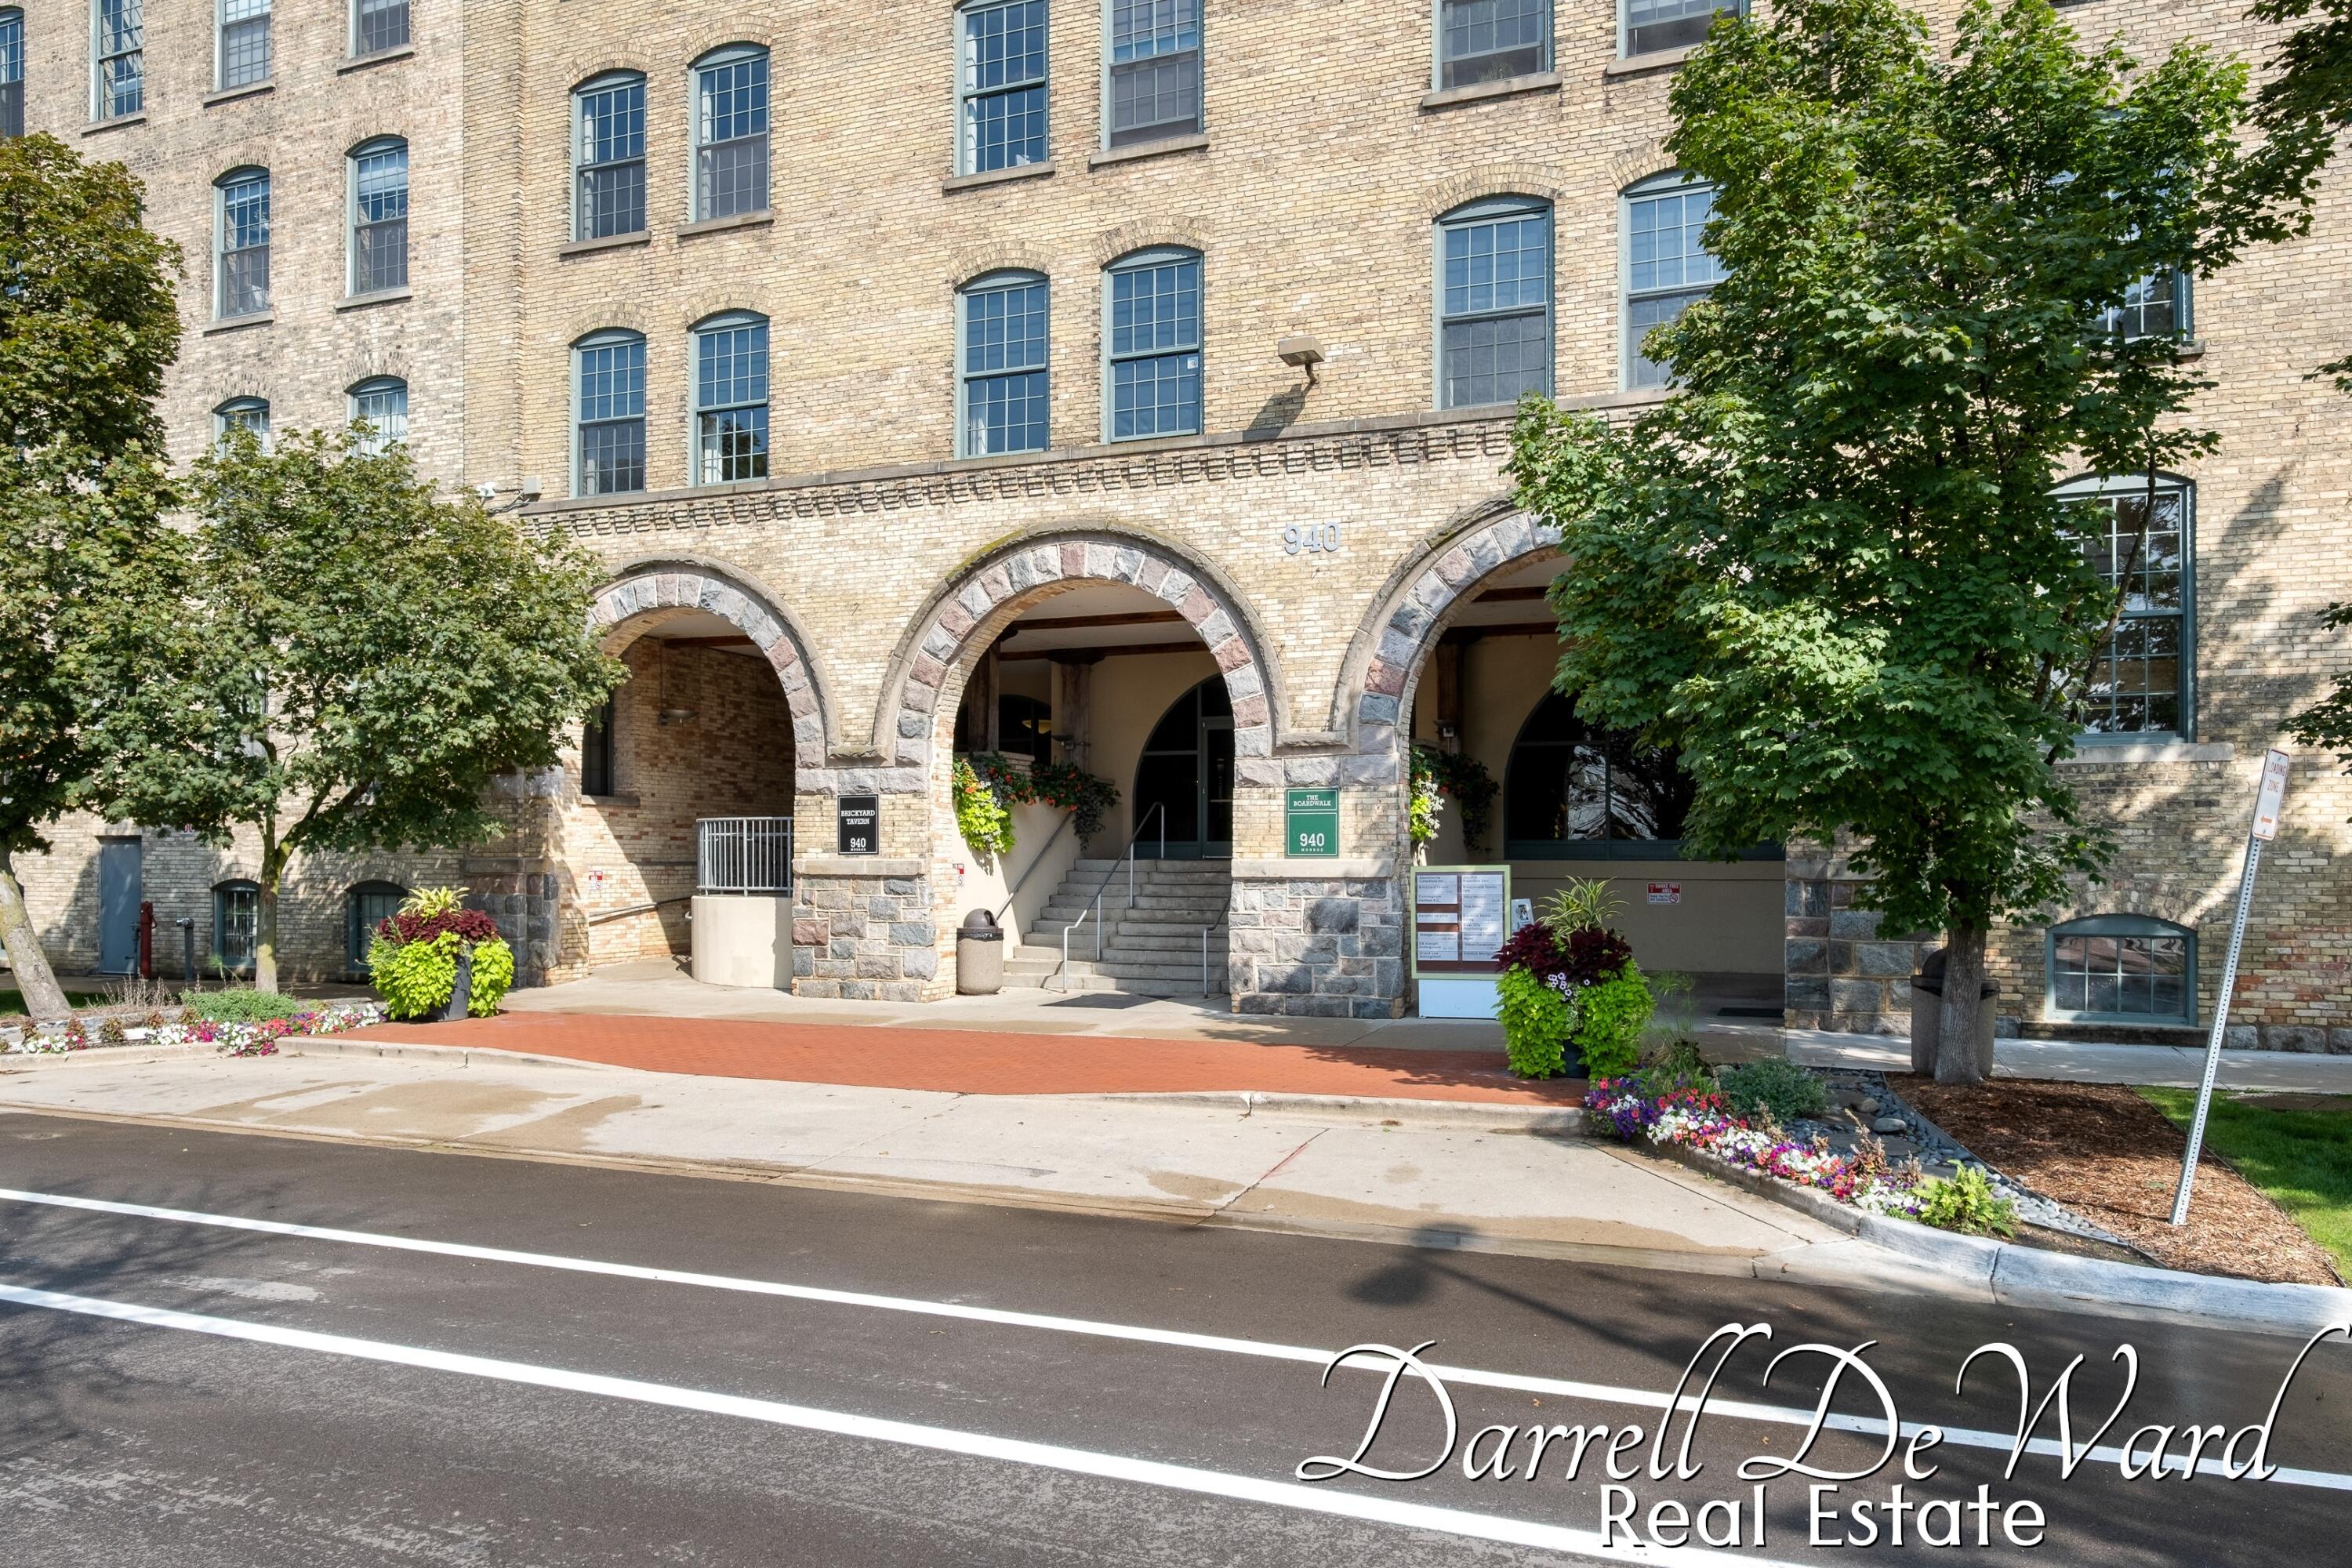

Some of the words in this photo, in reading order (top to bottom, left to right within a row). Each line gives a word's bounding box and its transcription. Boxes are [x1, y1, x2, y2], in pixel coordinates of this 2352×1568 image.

[1284, 521, 1341, 555] 940
[2268, 762, 2286, 776] LOADING
[2267, 779, 2281, 793] ZONE
[850, 837, 866, 848] 940
[1300, 833, 1325, 847] 940
